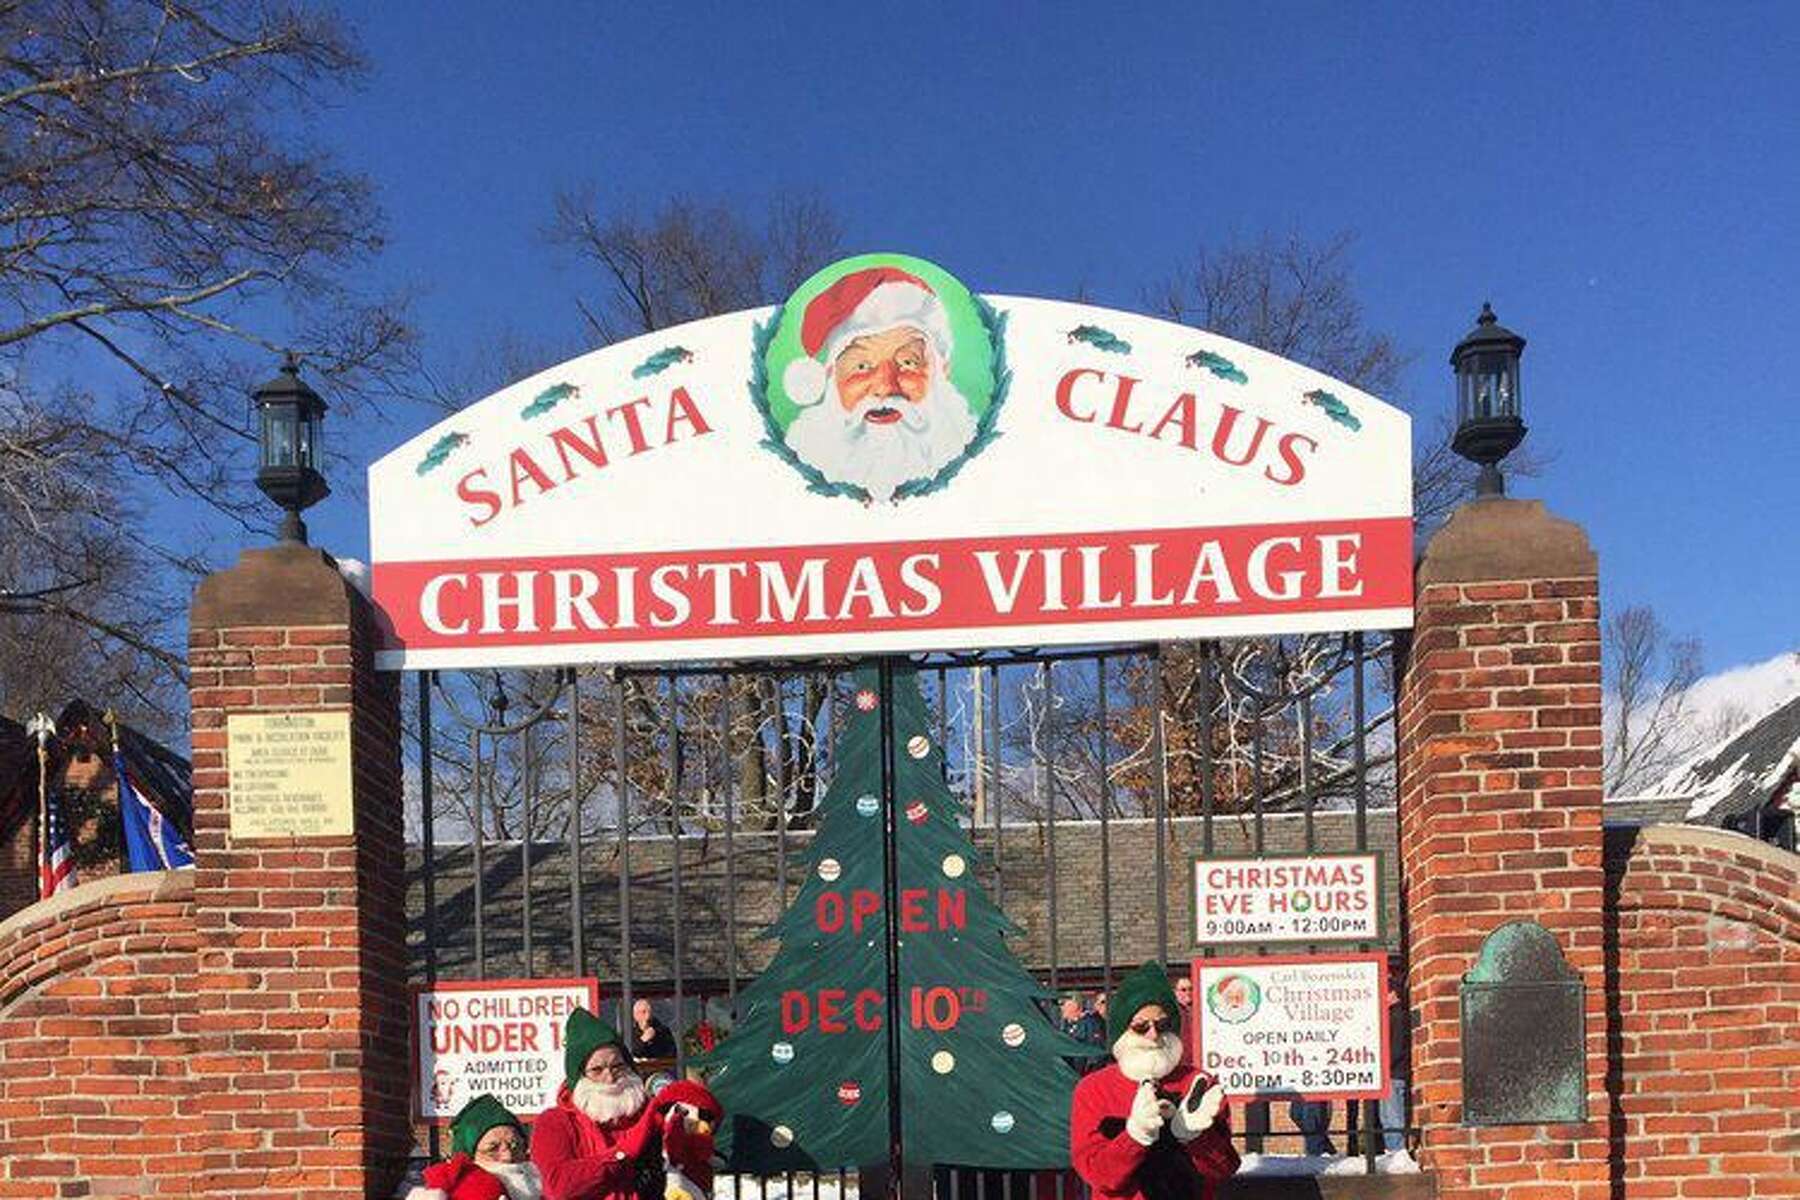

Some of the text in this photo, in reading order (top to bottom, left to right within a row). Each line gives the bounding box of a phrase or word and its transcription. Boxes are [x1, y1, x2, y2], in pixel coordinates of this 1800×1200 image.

[457, 367, 1318, 525] SANTA CLAUS
[418, 533, 1364, 637] CHRISTMAS VILLAGE
[1207, 864, 1365, 889] CHRISTMAS
[815, 888, 968, 937] OPEN
[1206, 890, 1369, 915] EVE HOURS
[1206, 920, 1273, 935] 9:00AM
[1293, 916, 1367, 934] 12:00PM
[1265, 985, 1373, 1003] Christmas
[429, 995, 581, 1021] NO CHILDREN
[781, 989, 883, 1035] DEC
[1283, 1003, 1356, 1023] Village
[431, 1022, 539, 1054] UNDER
[1243, 1029, 1340, 1046] OPEN DAILY
[464, 1058, 548, 1074] ADMITTED
[1207, 1051, 1253, 1069] Dec.
[1263, 1049, 1305, 1068] 10th
[1326, 1047, 1376, 1065] 24th
[468, 1076, 544, 1091] WITHOUT
[1302, 1069, 1374, 1087] 8:30PM
